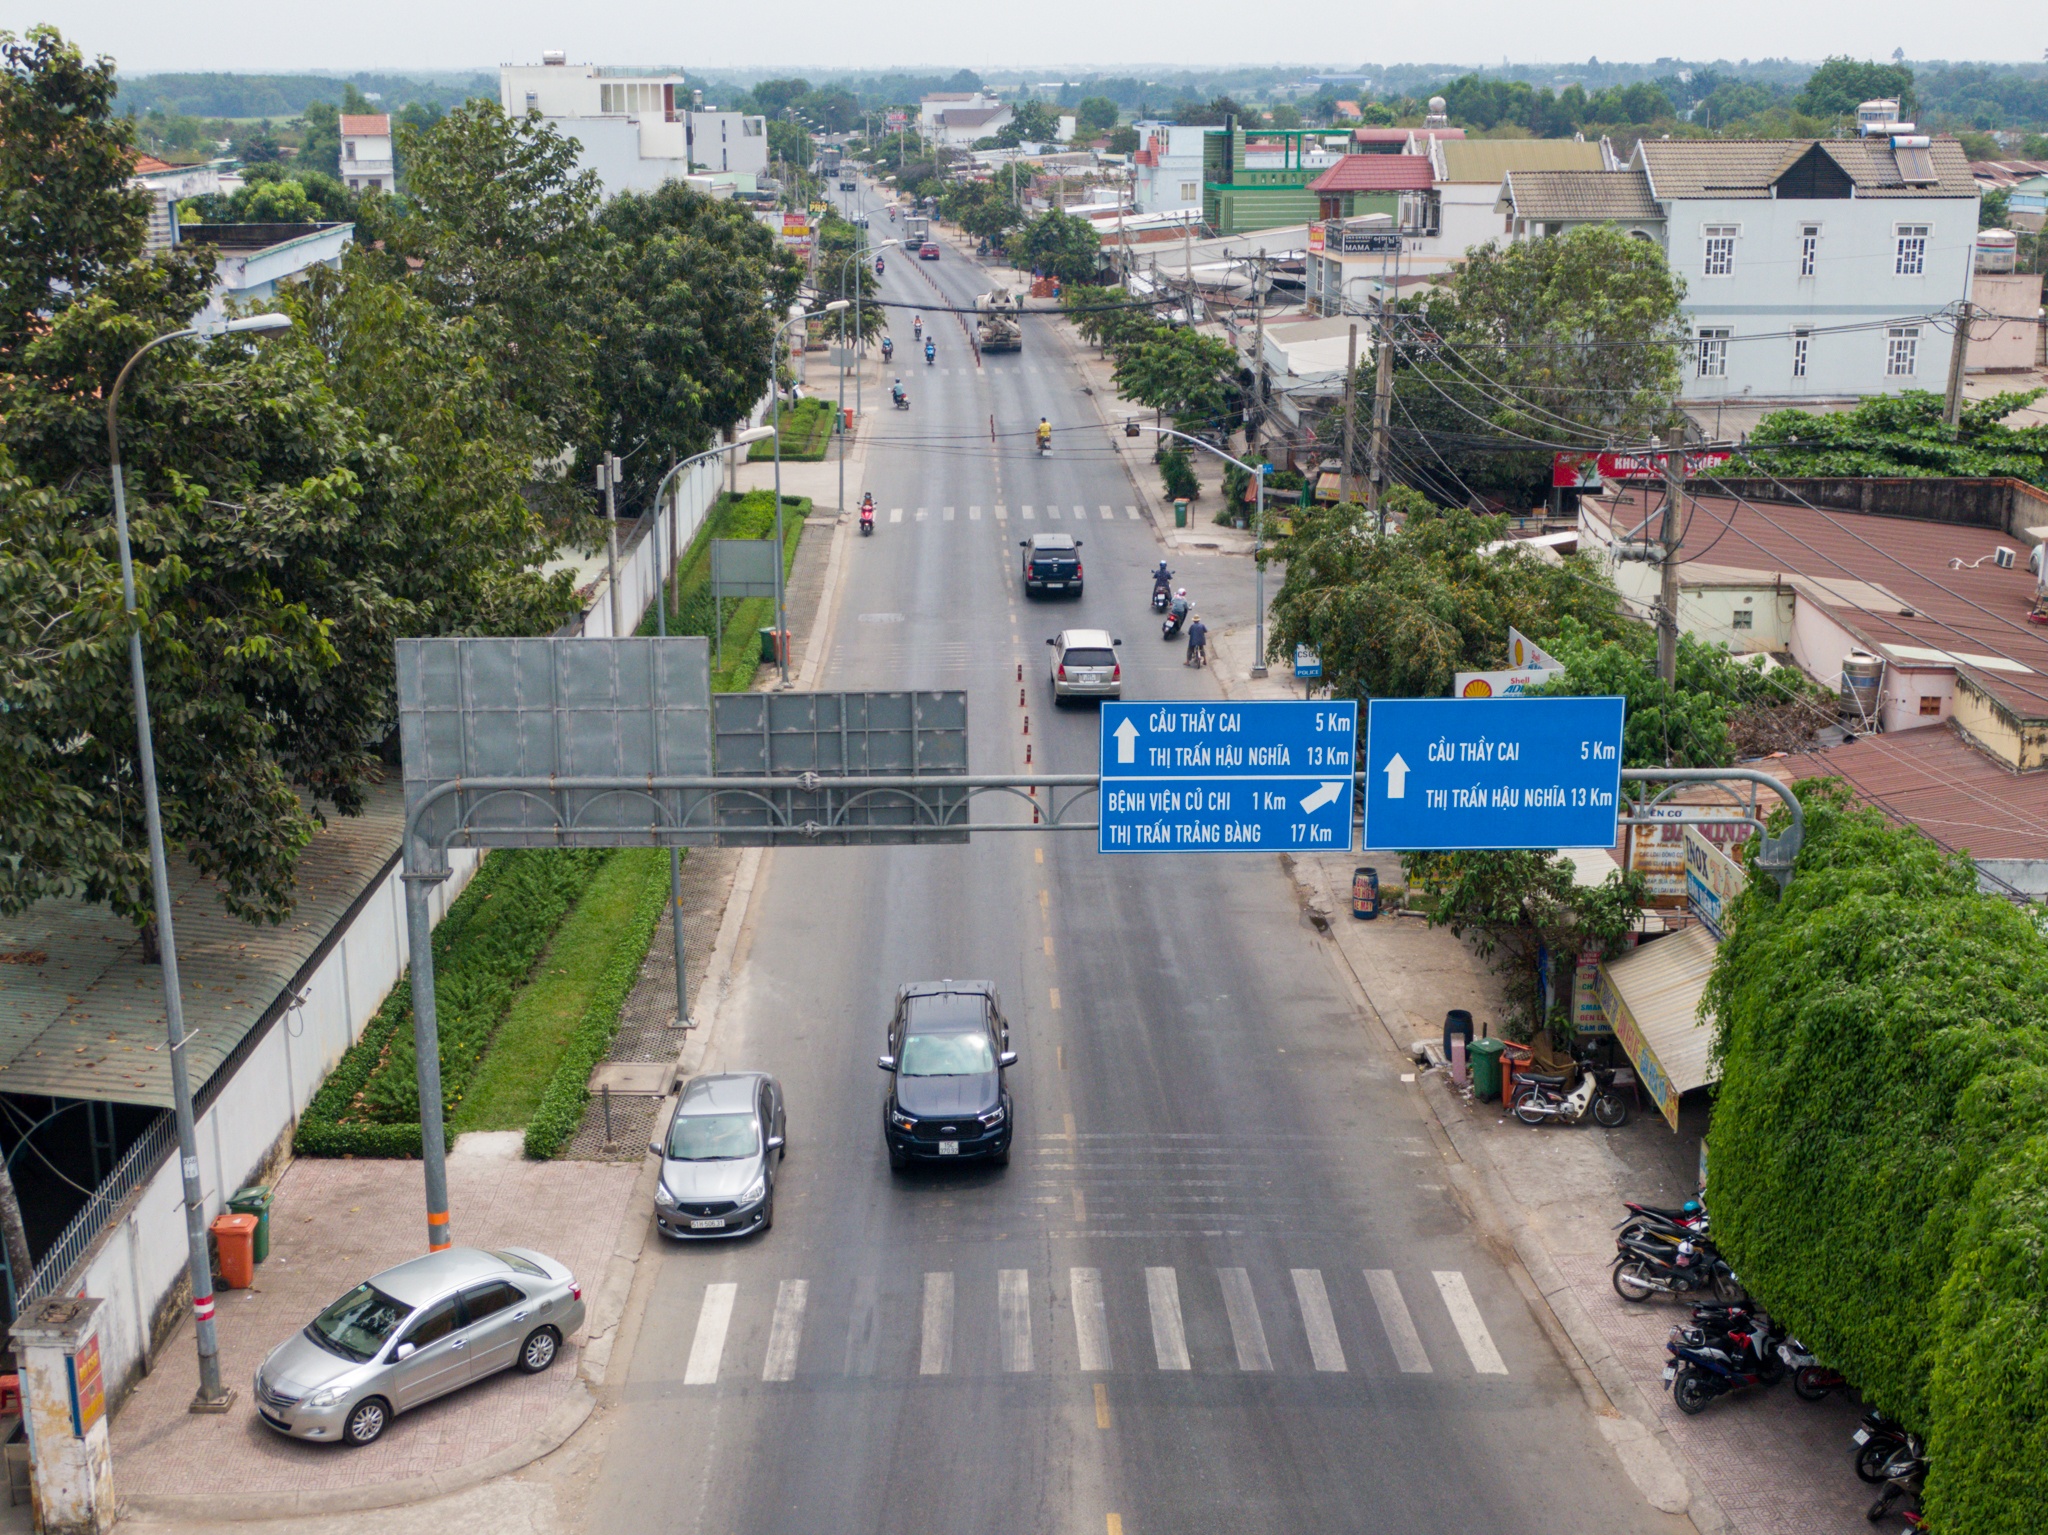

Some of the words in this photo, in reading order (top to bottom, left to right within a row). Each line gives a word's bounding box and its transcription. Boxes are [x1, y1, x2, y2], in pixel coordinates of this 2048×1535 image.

[1150, 707, 1176, 733] CẦU
[1180, 707, 1216, 733] THẦY
[1220, 712, 1240, 732] CAI
[1316, 712, 1324, 732] 5
[1329, 712, 1351, 732] Km
[1149, 747, 1171, 769] THỊ
[1175, 741, 1211, 767] TRẤN
[1216, 744, 1243, 769] HẬU
[1249, 743, 1291, 766] NGHĨA
[1307, 746, 1323, 766] 13
[1327, 746, 1349, 765] Km
[1429, 735, 1455, 762] CẦU
[1459, 735, 1494, 762] THẦY
[1498, 742, 1520, 761] CAI
[1581, 741, 1590, 760] 5
[1594, 741, 1616, 760] Km
[1108, 789, 1145, 814] BỆNH
[1149, 789, 1181, 813] VIỆN
[1185, 787, 1203, 811] CỦ
[1208, 791, 1231, 811] CHI
[1252, 791, 1259, 810] 1
[1264, 791, 1286, 810] Km
[1426, 789, 1448, 811] THỊ
[1452, 782, 1488, 808] TRẤN
[1492, 785, 1520, 811] HẬU
[1525, 784, 1566, 807] NGHĨA
[1571, 787, 1587, 807] 13
[1591, 787, 1613, 806] Km
[1109, 825, 1131, 846] THỊ
[1135, 818, 1171, 844] TRẤN
[1175, 819, 1220, 843] TRẢNG
[1224, 820, 1261, 843] BÀNG
[1291, 823, 1306, 842] 17
[1310, 823, 1332, 842] Km
[1685, 834, 1709, 880] INOX
